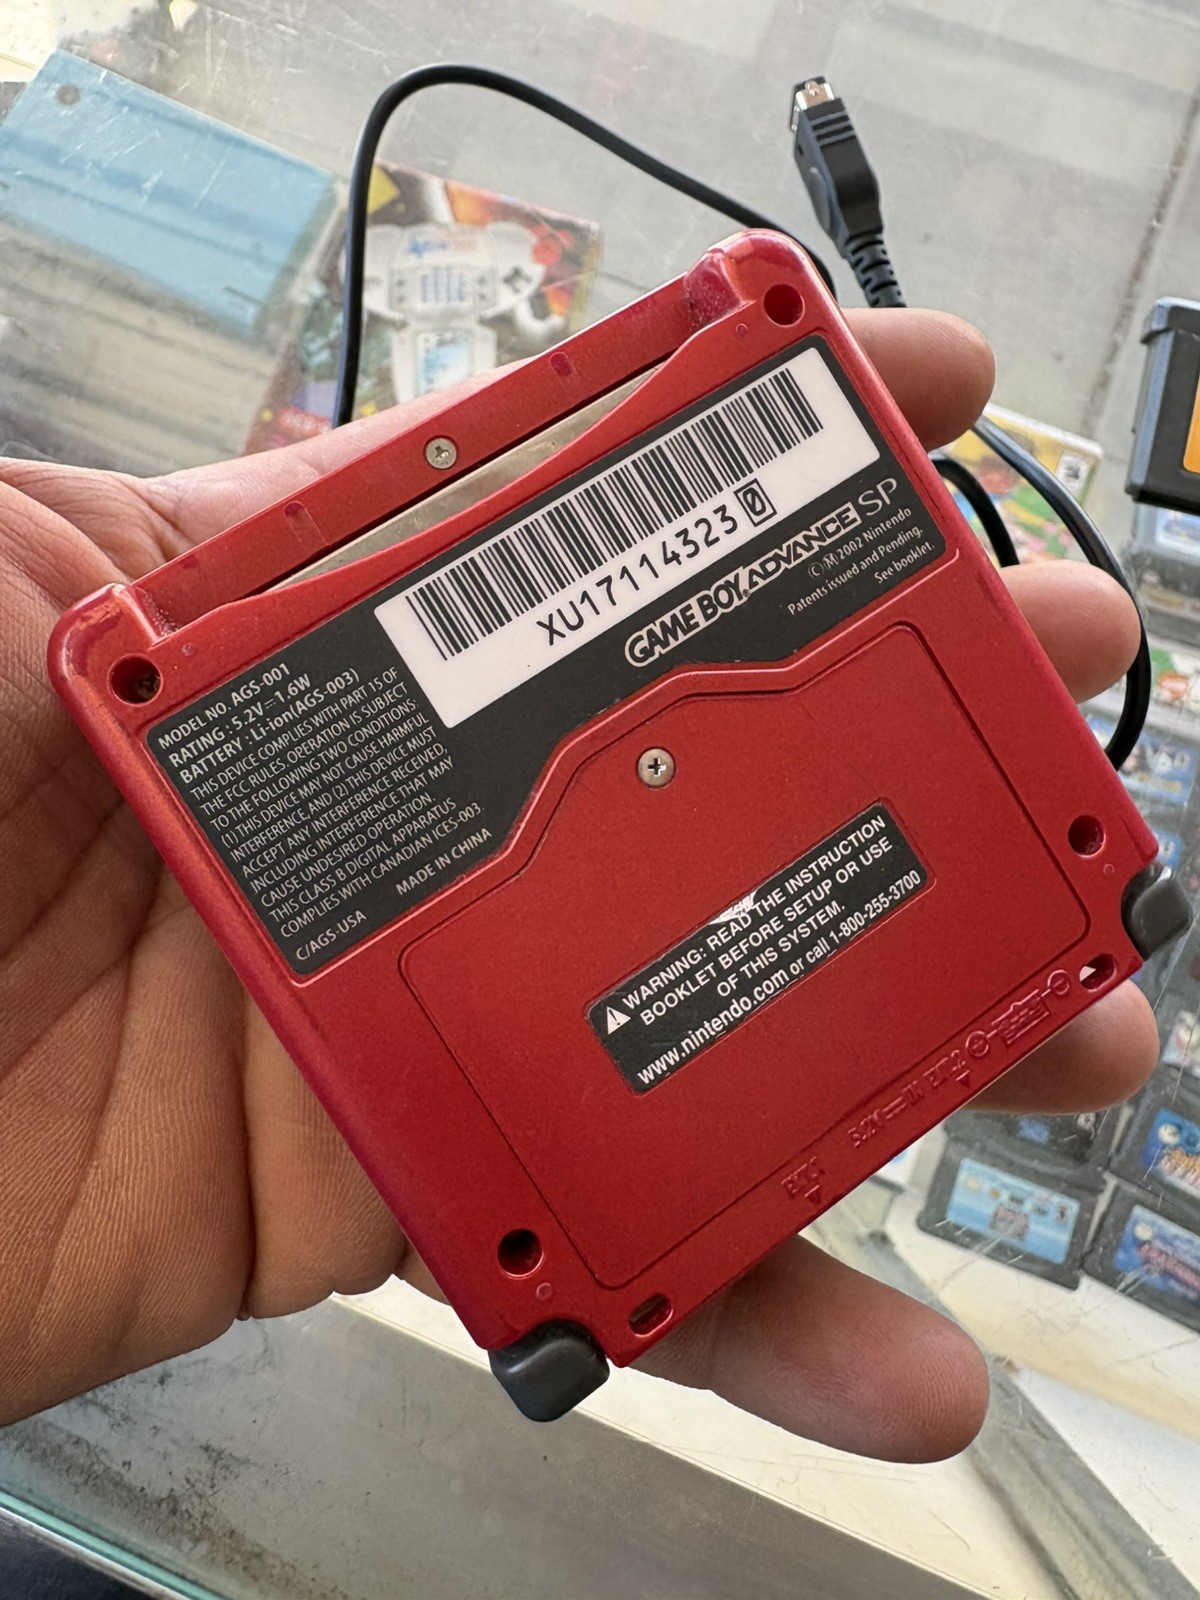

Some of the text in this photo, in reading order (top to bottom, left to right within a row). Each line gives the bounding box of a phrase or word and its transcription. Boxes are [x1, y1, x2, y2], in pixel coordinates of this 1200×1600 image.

[536, 504, 737, 645] XU17114323
[619, 601, 703, 670] GAME
[738, 501, 862, 594] ADVANCE
[855, 475, 905, 519] SP
[787, 526, 922, 615] Patents issued and Pending.
[861, 504, 914, 544] Nintendo
[874, 541, 934, 583] See booklet.
[158, 663, 289, 749] MODEL NO. AGS-001
[168, 726, 225, 767] RATING
[179, 736, 242, 783] BATTERY
[249, 667, 359, 740] Li-ion(AGS-003)
[189, 666, 397, 800] THIS DEVICE COMPLIES WITH PART 15 OF
[199, 681, 407, 815] THE FCC RULES. OPERATION IS SUBJECT
[209, 698, 418, 831] TO THE FOLLOWING TWO CONDITIONS:
[221, 712, 429, 848] (1) THIS DEVICE MAY NOT CAUSE HARMFUL
[230, 725, 436, 862] INTERFERENCE, AND (2) THIS DEVICE MUST
[242, 742, 447, 878] ACCEPT ANY INTERFERENCE RECEIVED,
[249, 755, 453, 893] INCLUDING INTERFERENCE THAT MAY
[260, 791, 435, 906] CAUSE UNDESIRED OPERATION.
[269, 797, 456, 921] THIS CLASS B DIGITAL APPARATUS
[280, 893, 340, 937] COMPLIES
[337, 872, 371, 899] WITH
[370, 832, 433, 878] CANADIAN
[395, 828, 491, 895] MADE IN CHINA
[621, 813, 887, 1011] WARNING: READ THE INSTRUCTION
[295, 910, 366, 960] C/AGS-USA
[635, 868, 923, 1086] www.nintendo.com or call 1-800-255-3700
[639, 836, 892, 1025] BOOKLET BEFORE SETUP OR USE
[717, 900, 844, 996] OF THIS SYSTEM.
